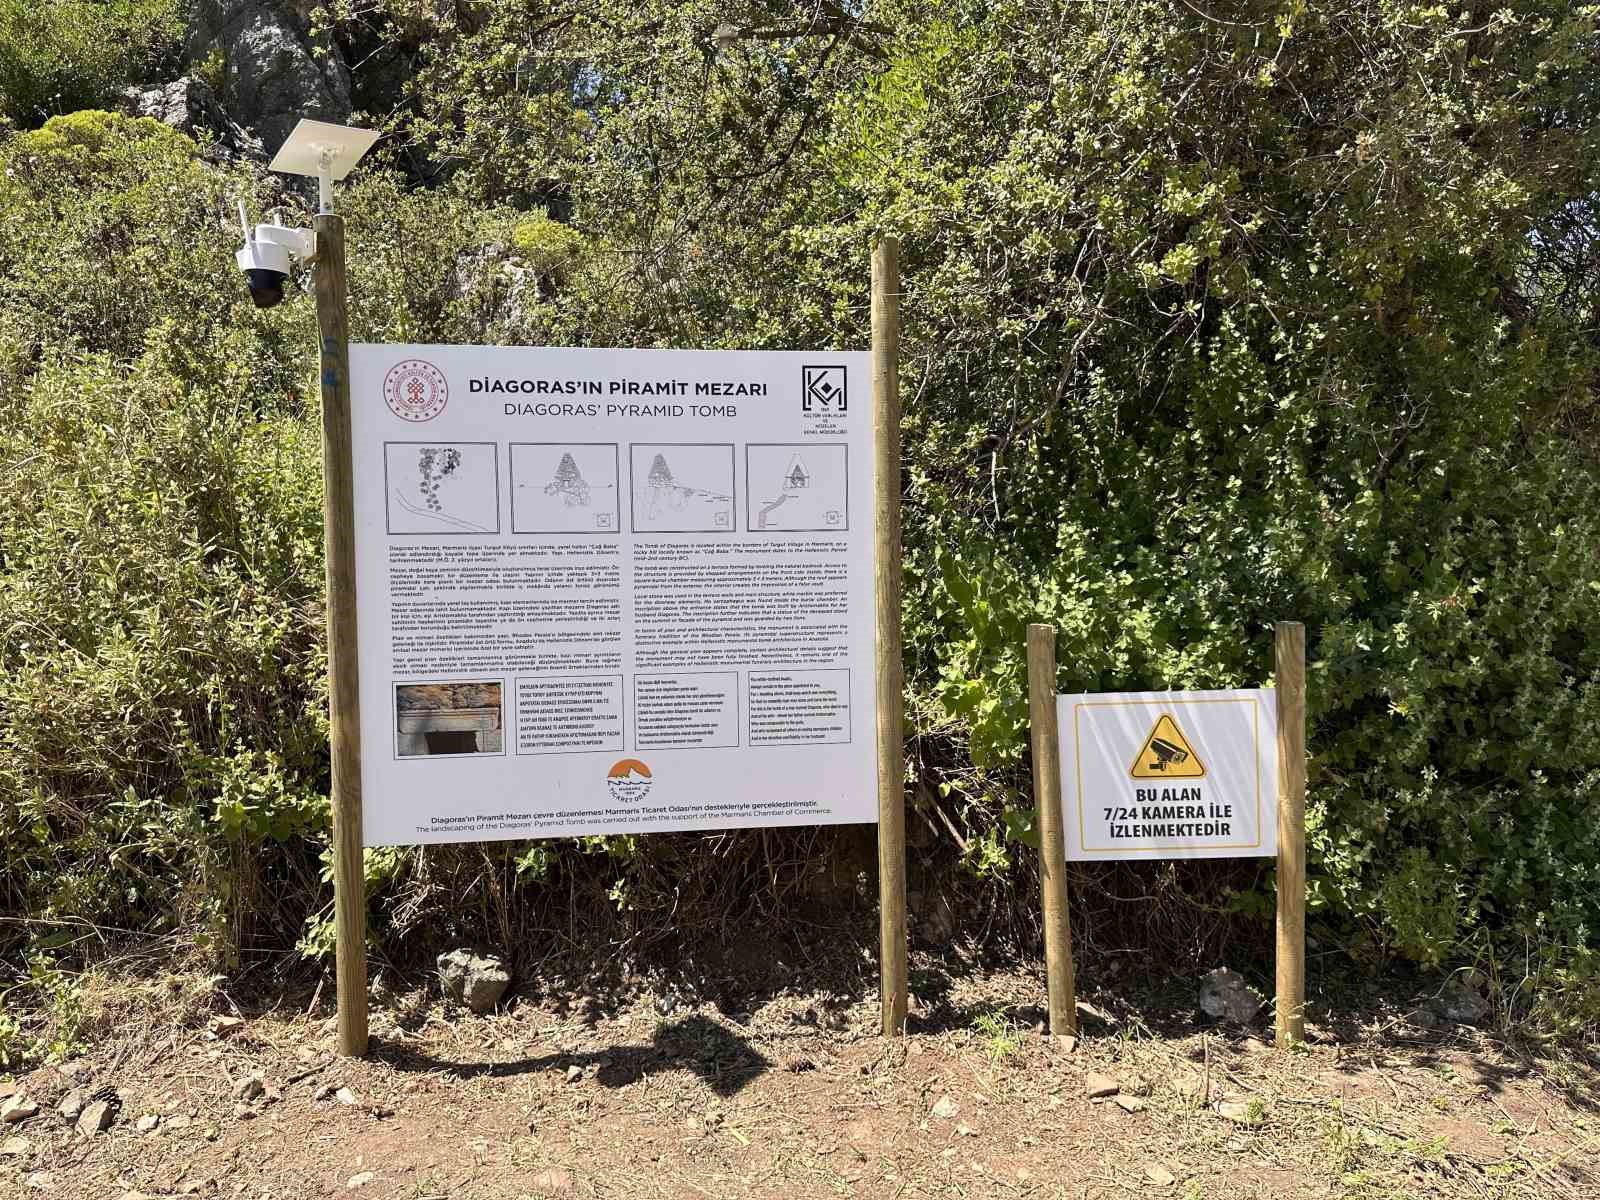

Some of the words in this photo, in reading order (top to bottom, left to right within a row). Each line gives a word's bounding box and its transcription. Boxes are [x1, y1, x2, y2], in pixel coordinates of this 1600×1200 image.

[610, 378, 688, 395] PİRAMİT
[696, 383, 767, 396] MEZARI
[607, 404, 684, 417] PYRAMID
[688, 405, 737, 417] TOMB
[1136, 788, 1157, 802] BU
[1161, 788, 1201, 801] ALAN
[476, 814, 504, 822] Piramit
[1104, 807, 1138, 821] 7/24
[1142, 806, 1206, 819] KAMERA
[1210, 802, 1232, 818] İLE
[1110, 820, 1231, 838] İZLENMEKTEDİR
